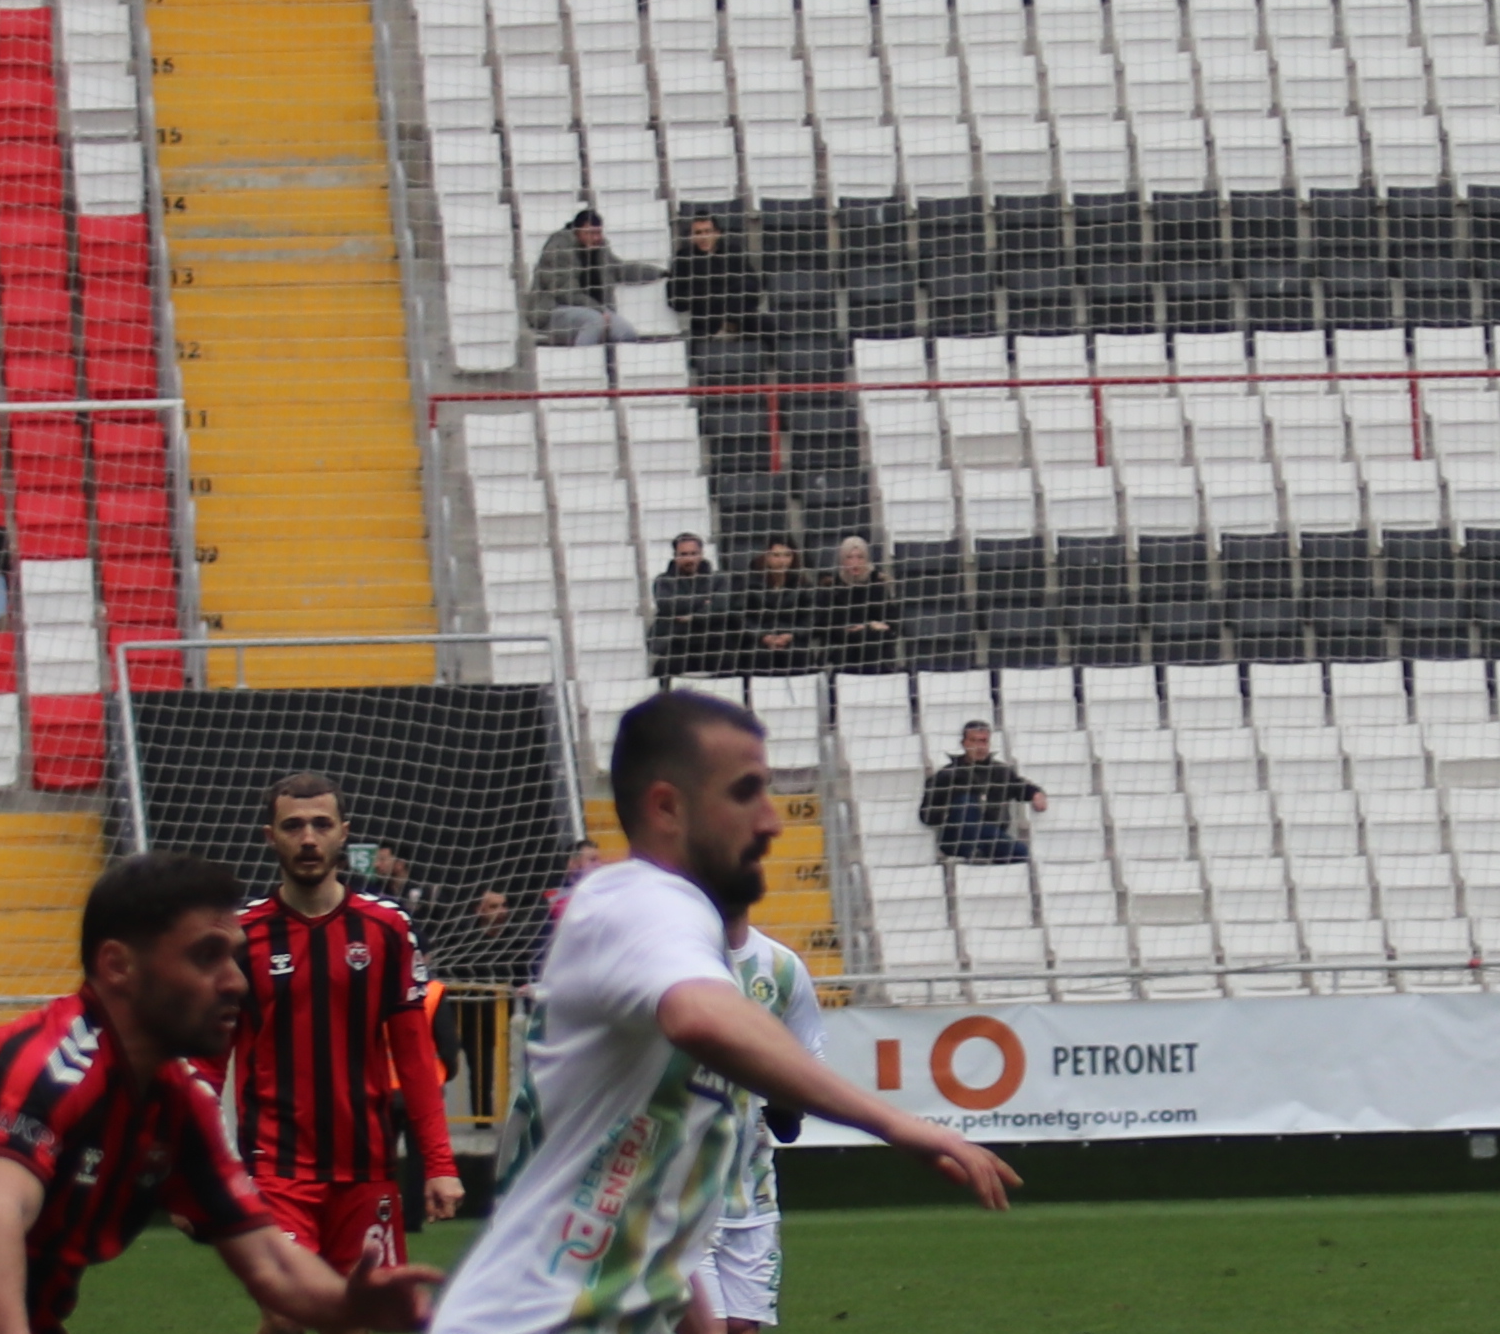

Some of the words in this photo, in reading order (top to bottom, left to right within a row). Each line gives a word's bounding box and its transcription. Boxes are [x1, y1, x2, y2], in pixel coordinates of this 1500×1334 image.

[157, 127, 182, 144] 15
[163, 196, 187, 214] 14
[170, 268, 195, 285] 13
[184, 410, 208, 427] 11
[788, 801, 815, 818] 05
[1053, 1043, 1198, 1076] PETRONET
[918, 1108, 1197, 1131] w.petronetgroup.com
